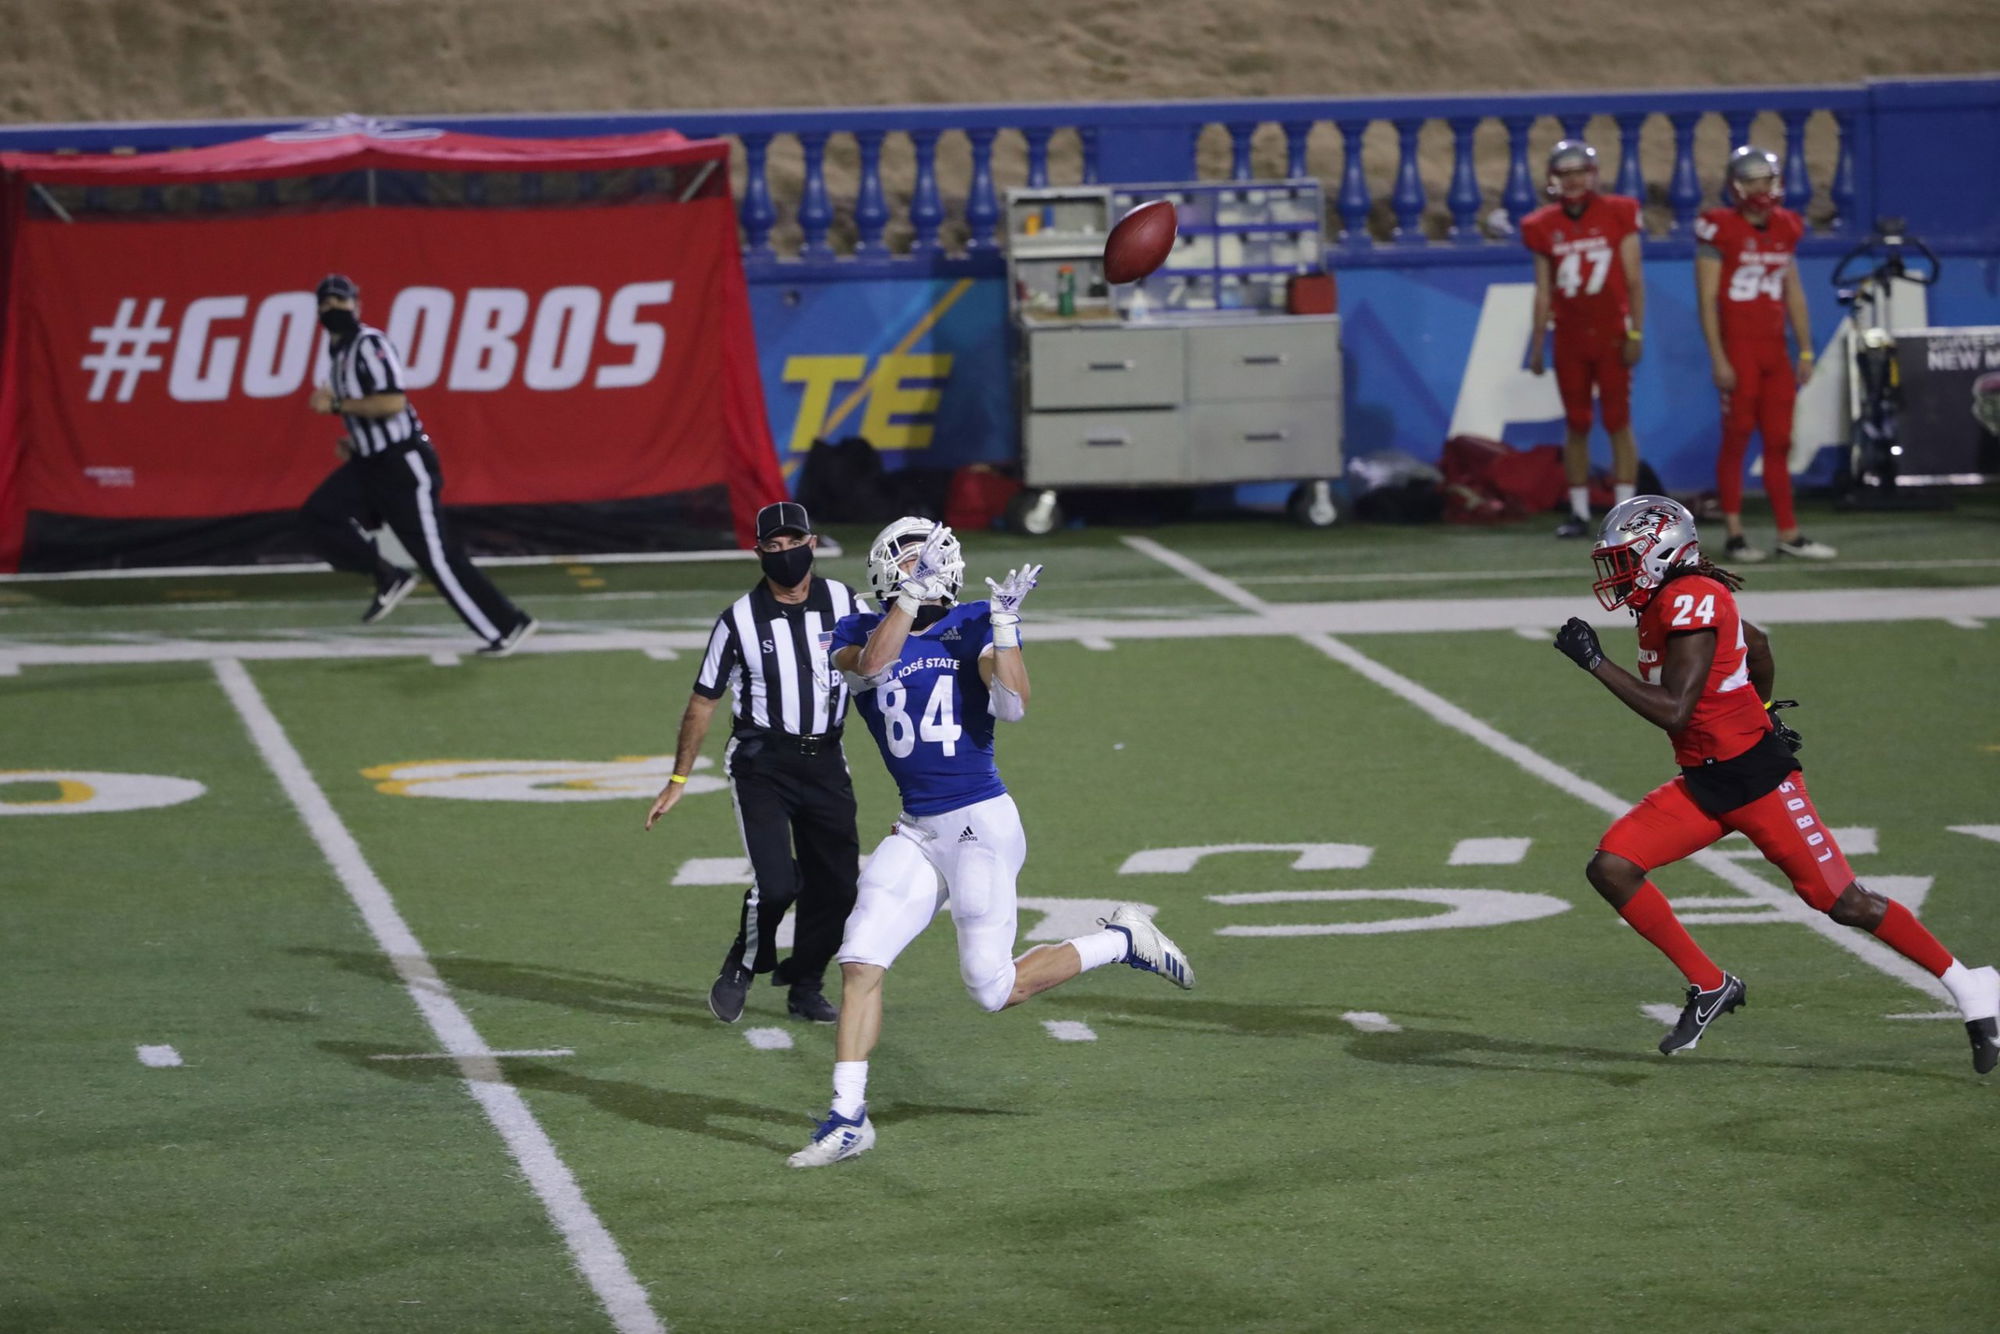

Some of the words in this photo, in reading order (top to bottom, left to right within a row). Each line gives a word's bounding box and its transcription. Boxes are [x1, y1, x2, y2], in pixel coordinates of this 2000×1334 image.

[1556, 248, 1613, 297] 47
[80, 281, 675, 402] #GOOBOS
[1672, 594, 1716, 627] 24
[761, 639, 775, 654] S
[925, 657, 961, 670] STATE
[876, 674, 963, 760] 84
[1778, 780, 1834, 864] LOBOS
